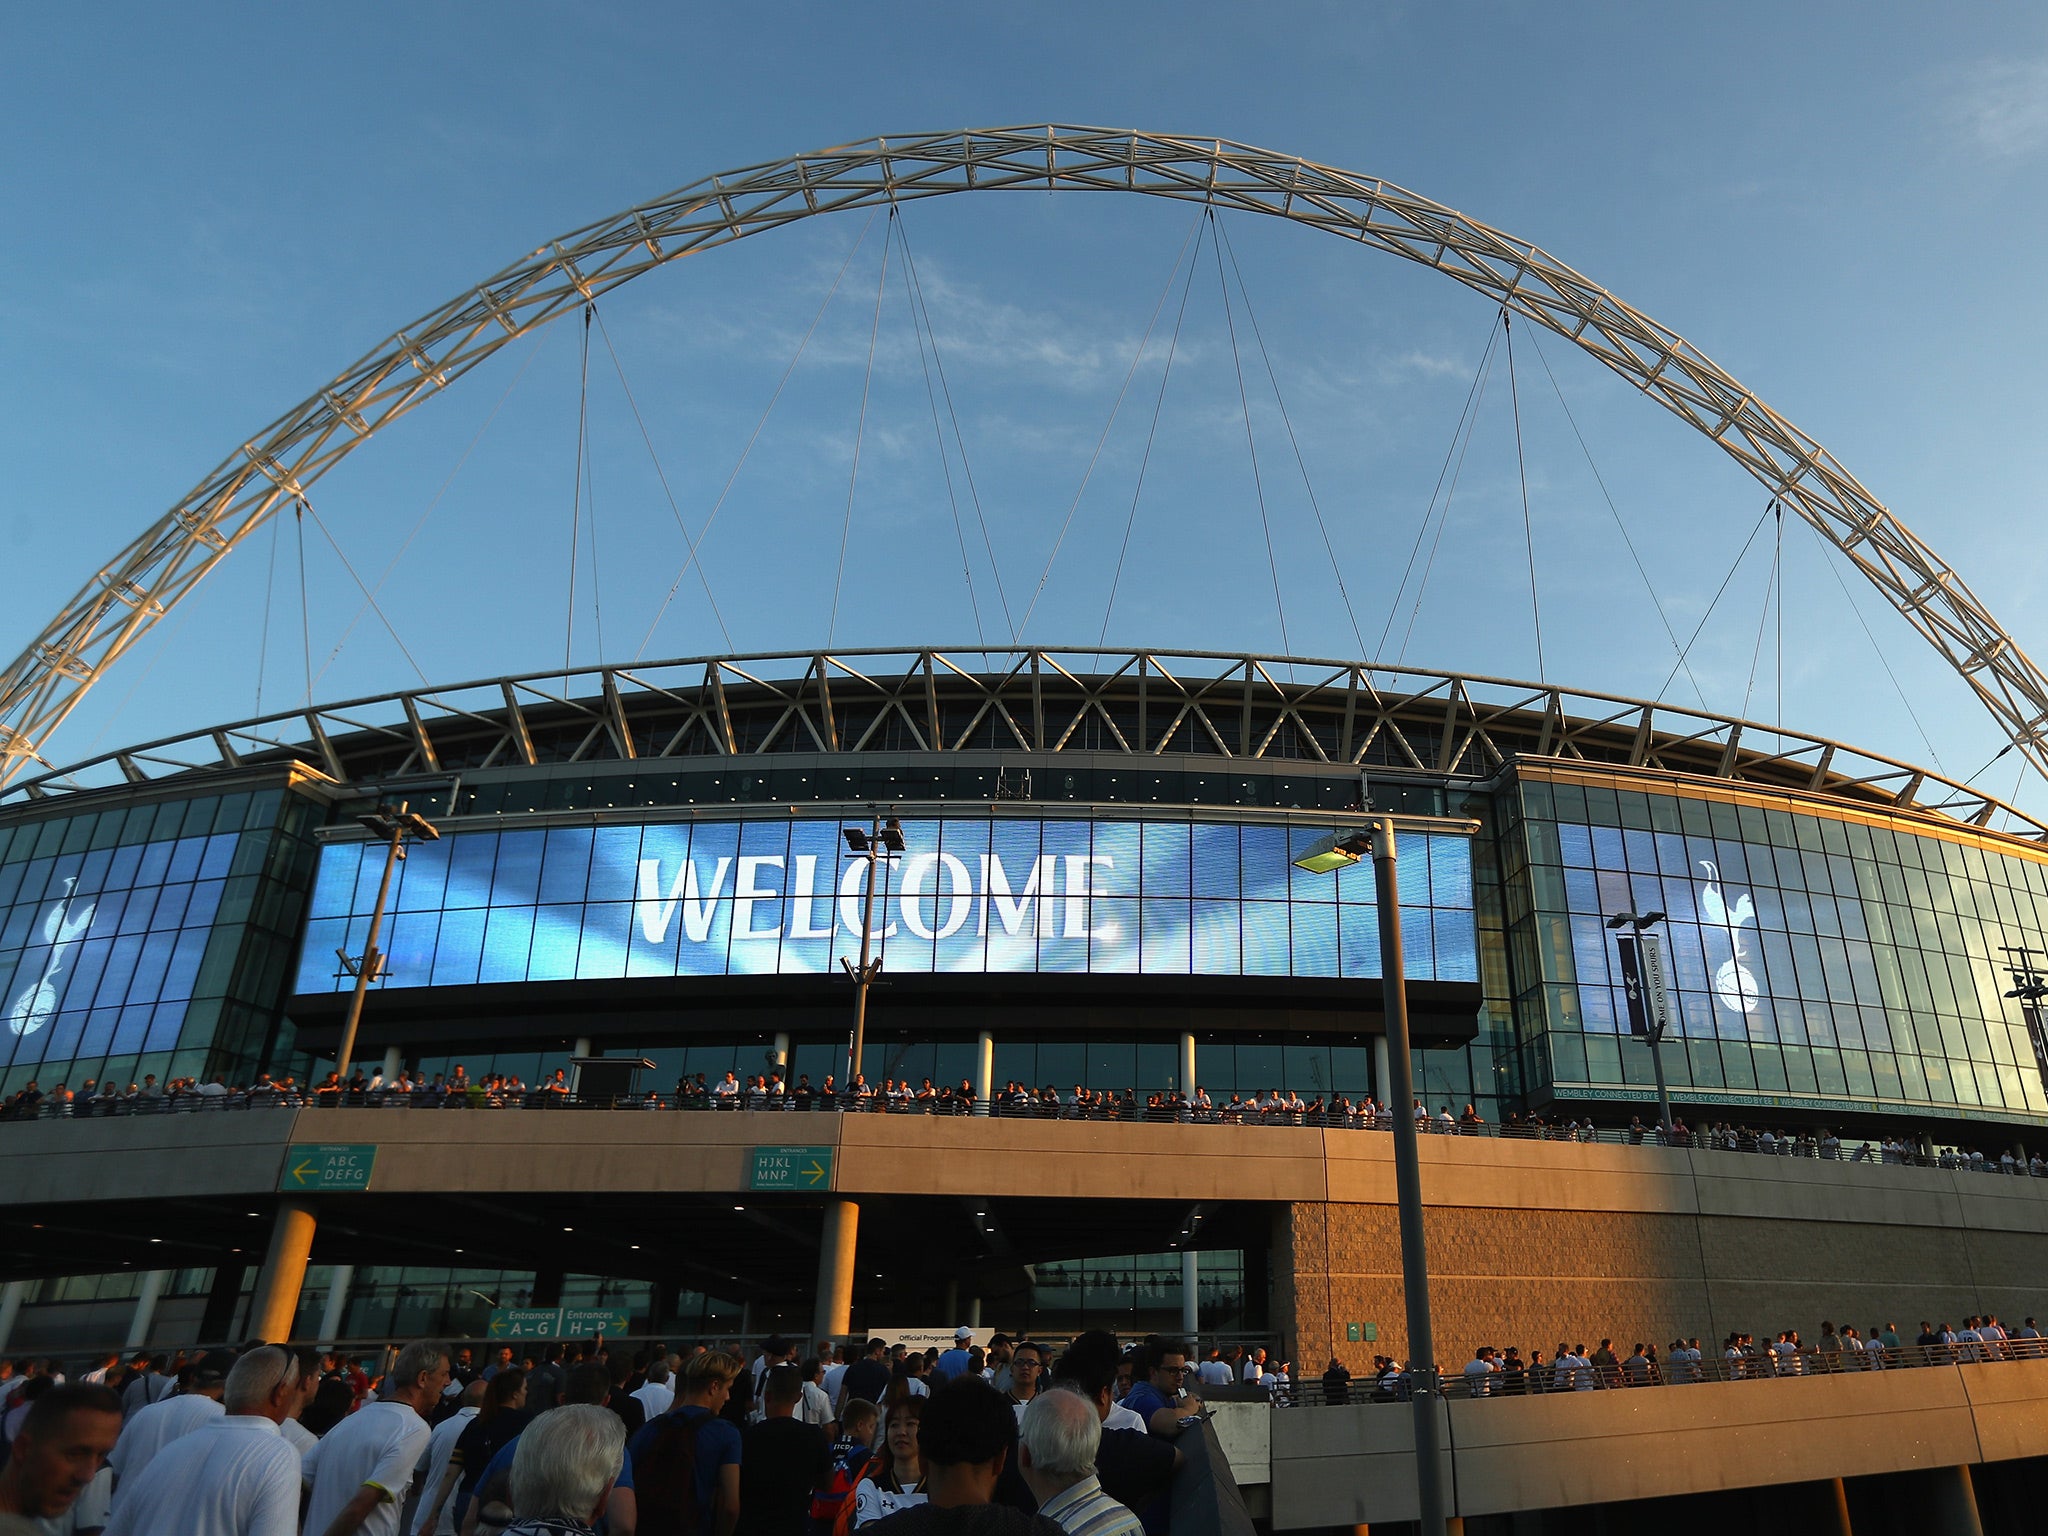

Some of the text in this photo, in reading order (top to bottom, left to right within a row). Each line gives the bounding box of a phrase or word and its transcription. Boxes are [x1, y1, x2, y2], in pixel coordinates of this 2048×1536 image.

[635, 852, 1117, 944] WELCOME
[1649, 947, 1659, 972] SPURS
[1653, 974, 1663, 990] YOU
[1555, 1089, 1592, 1098] WEMBLEY
[1595, 1090, 1642, 1099] CONNECTED
[1643, 1092, 1654, 1100] BY
[1672, 1092, 1707, 1102] WEMBLEY
[1709, 1094, 1753, 1104] CONNECTED
[1781, 1097, 1813, 1107] WEMBLEY
[328, 1155, 358, 1167] ABC
[759, 1157, 791, 1168] HJKL
[324, 1169, 364, 1180] DEFG
[757, 1170, 788, 1180] MNP
[508, 1310, 556, 1320] Entrances
[567, 1310, 613, 1320] Entrances
